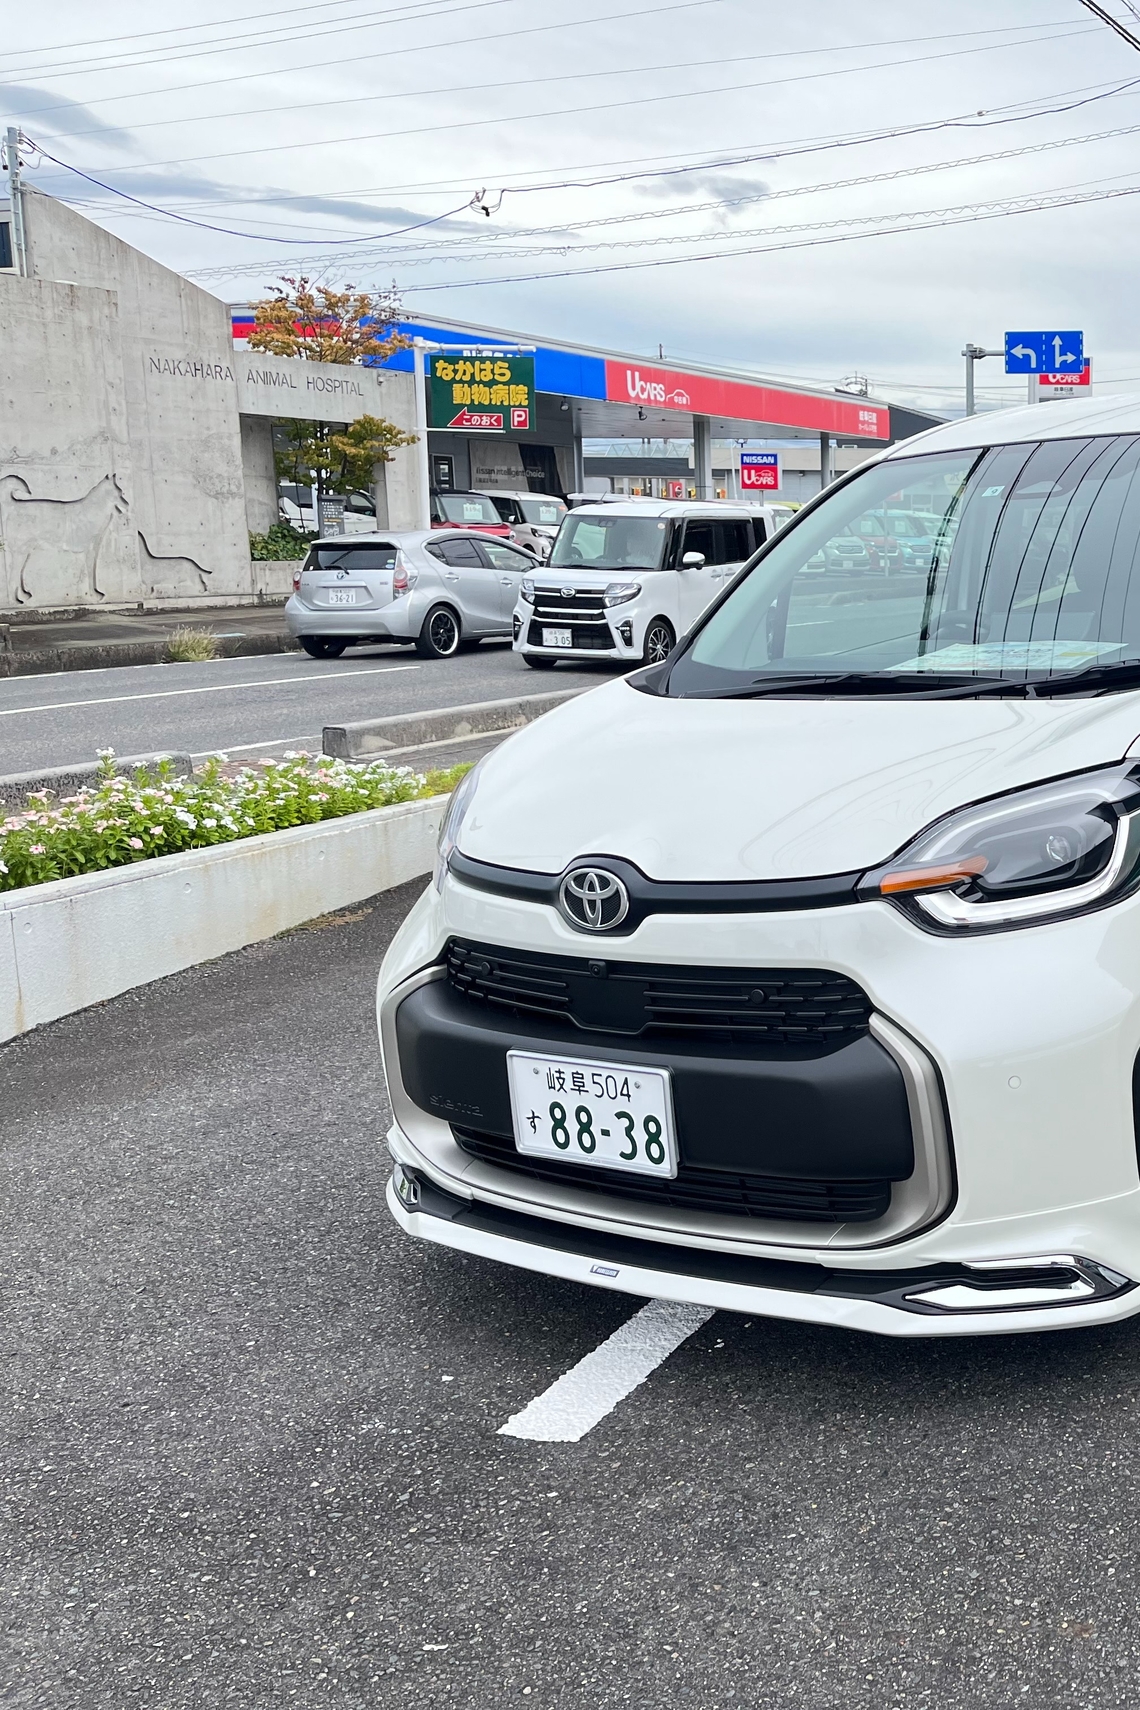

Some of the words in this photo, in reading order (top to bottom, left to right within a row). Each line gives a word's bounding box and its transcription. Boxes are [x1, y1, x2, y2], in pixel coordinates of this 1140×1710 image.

[149, 356, 234, 382] NAKAHARA
[246, 369, 297, 389] ANIMAL
[306, 376, 364, 397] HOSPITAL
[435, 360, 511, 382] なかはら
[452, 383, 529, 406] 動物病院
[462, 415, 498, 426] このおく
[513, 410, 526, 427] P
[743, 455, 775, 464] NISSAN
[334, 594, 354, 603] 36-21
[526, 1109, 542, 1135] す
[549, 1100, 666, 1165] 88-38
